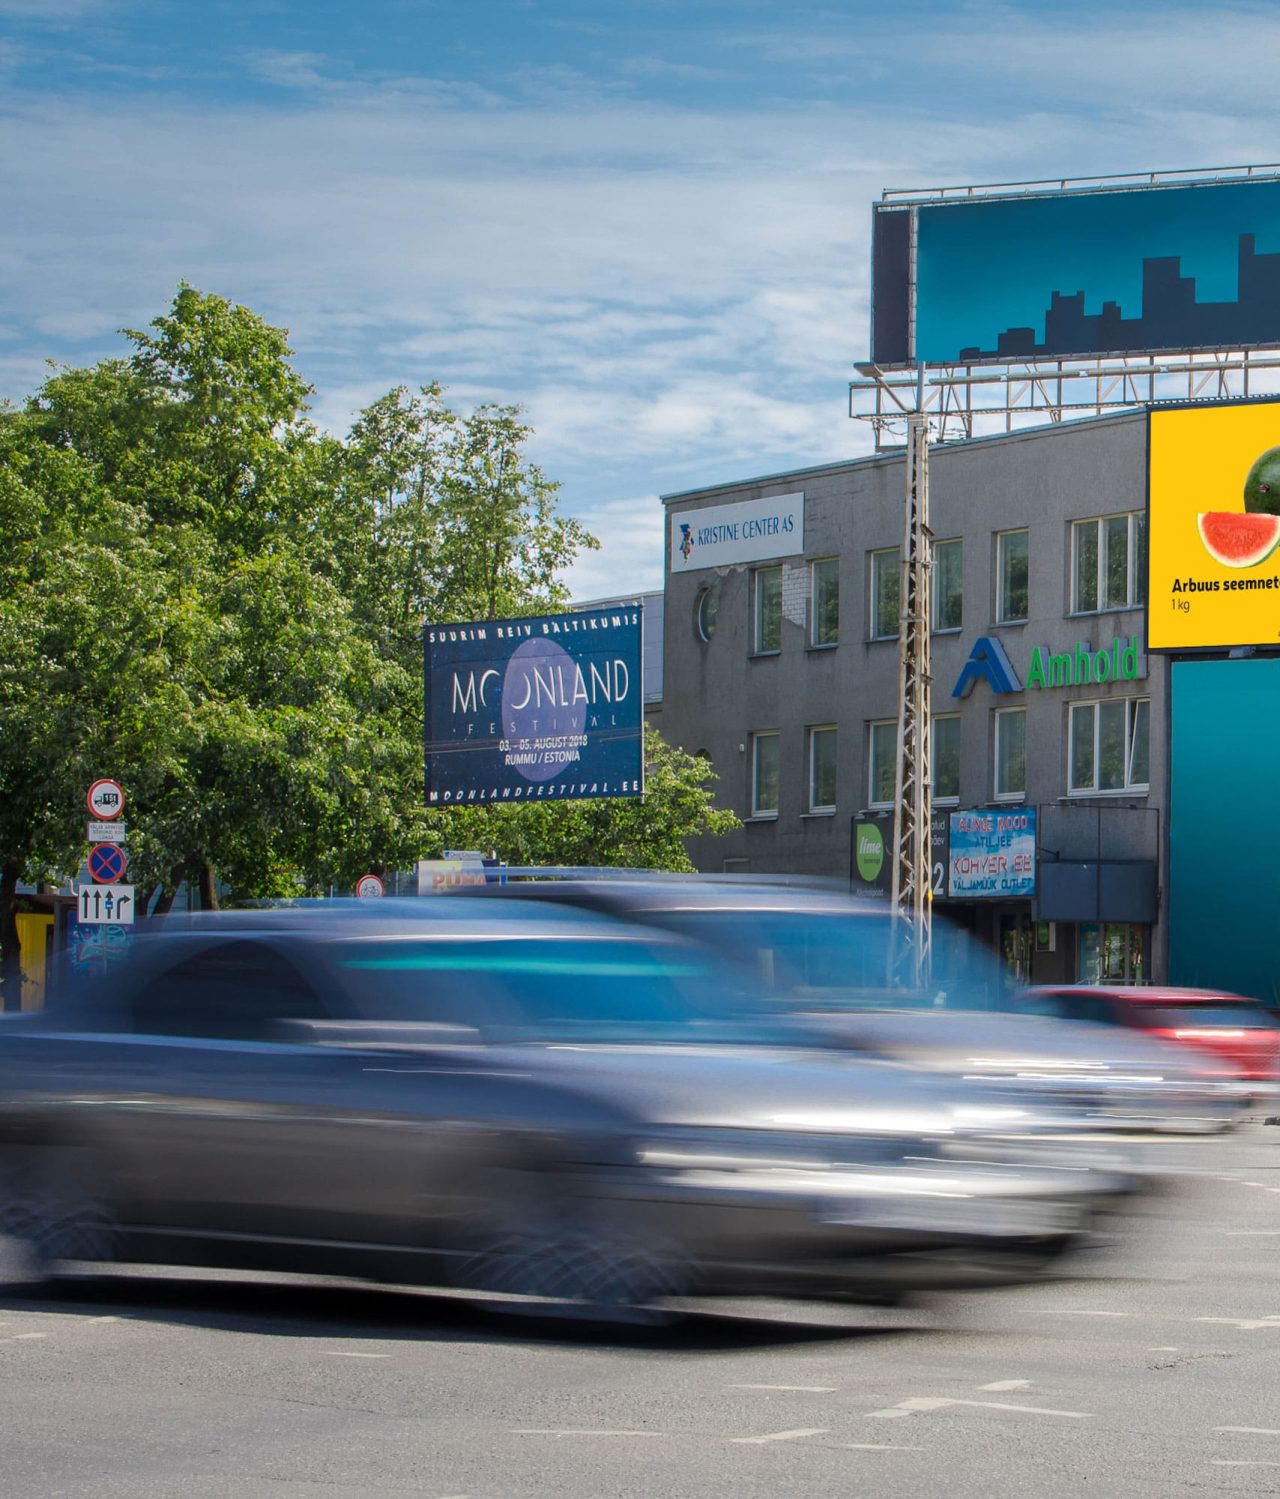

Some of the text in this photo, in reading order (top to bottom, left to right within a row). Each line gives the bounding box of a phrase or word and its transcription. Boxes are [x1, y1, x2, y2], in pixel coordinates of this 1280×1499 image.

[698, 514, 794, 546] KRISTINE CENTER AS
[1172, 578, 1220, 593] Arbuus
[1178, 599, 1190, 613] kg
[429, 613, 638, 643] SUURIM REIV BALTIKUMIS
[1027, 636, 1138, 688] Amhold
[452, 659, 629, 714] MOONLAND
[468, 714, 617, 735] FESTIVAL
[519, 738, 532, 750] 05.
[533, 735, 568, 750] AUGUST
[569, 735, 588, 747] 2018
[505, 752, 537, 766] RUMMU
[544, 750, 580, 764] ESTONIA
[430, 779, 639, 801] MOONLANDFESTIVAL.EE
[860, 836, 881, 854] lime
